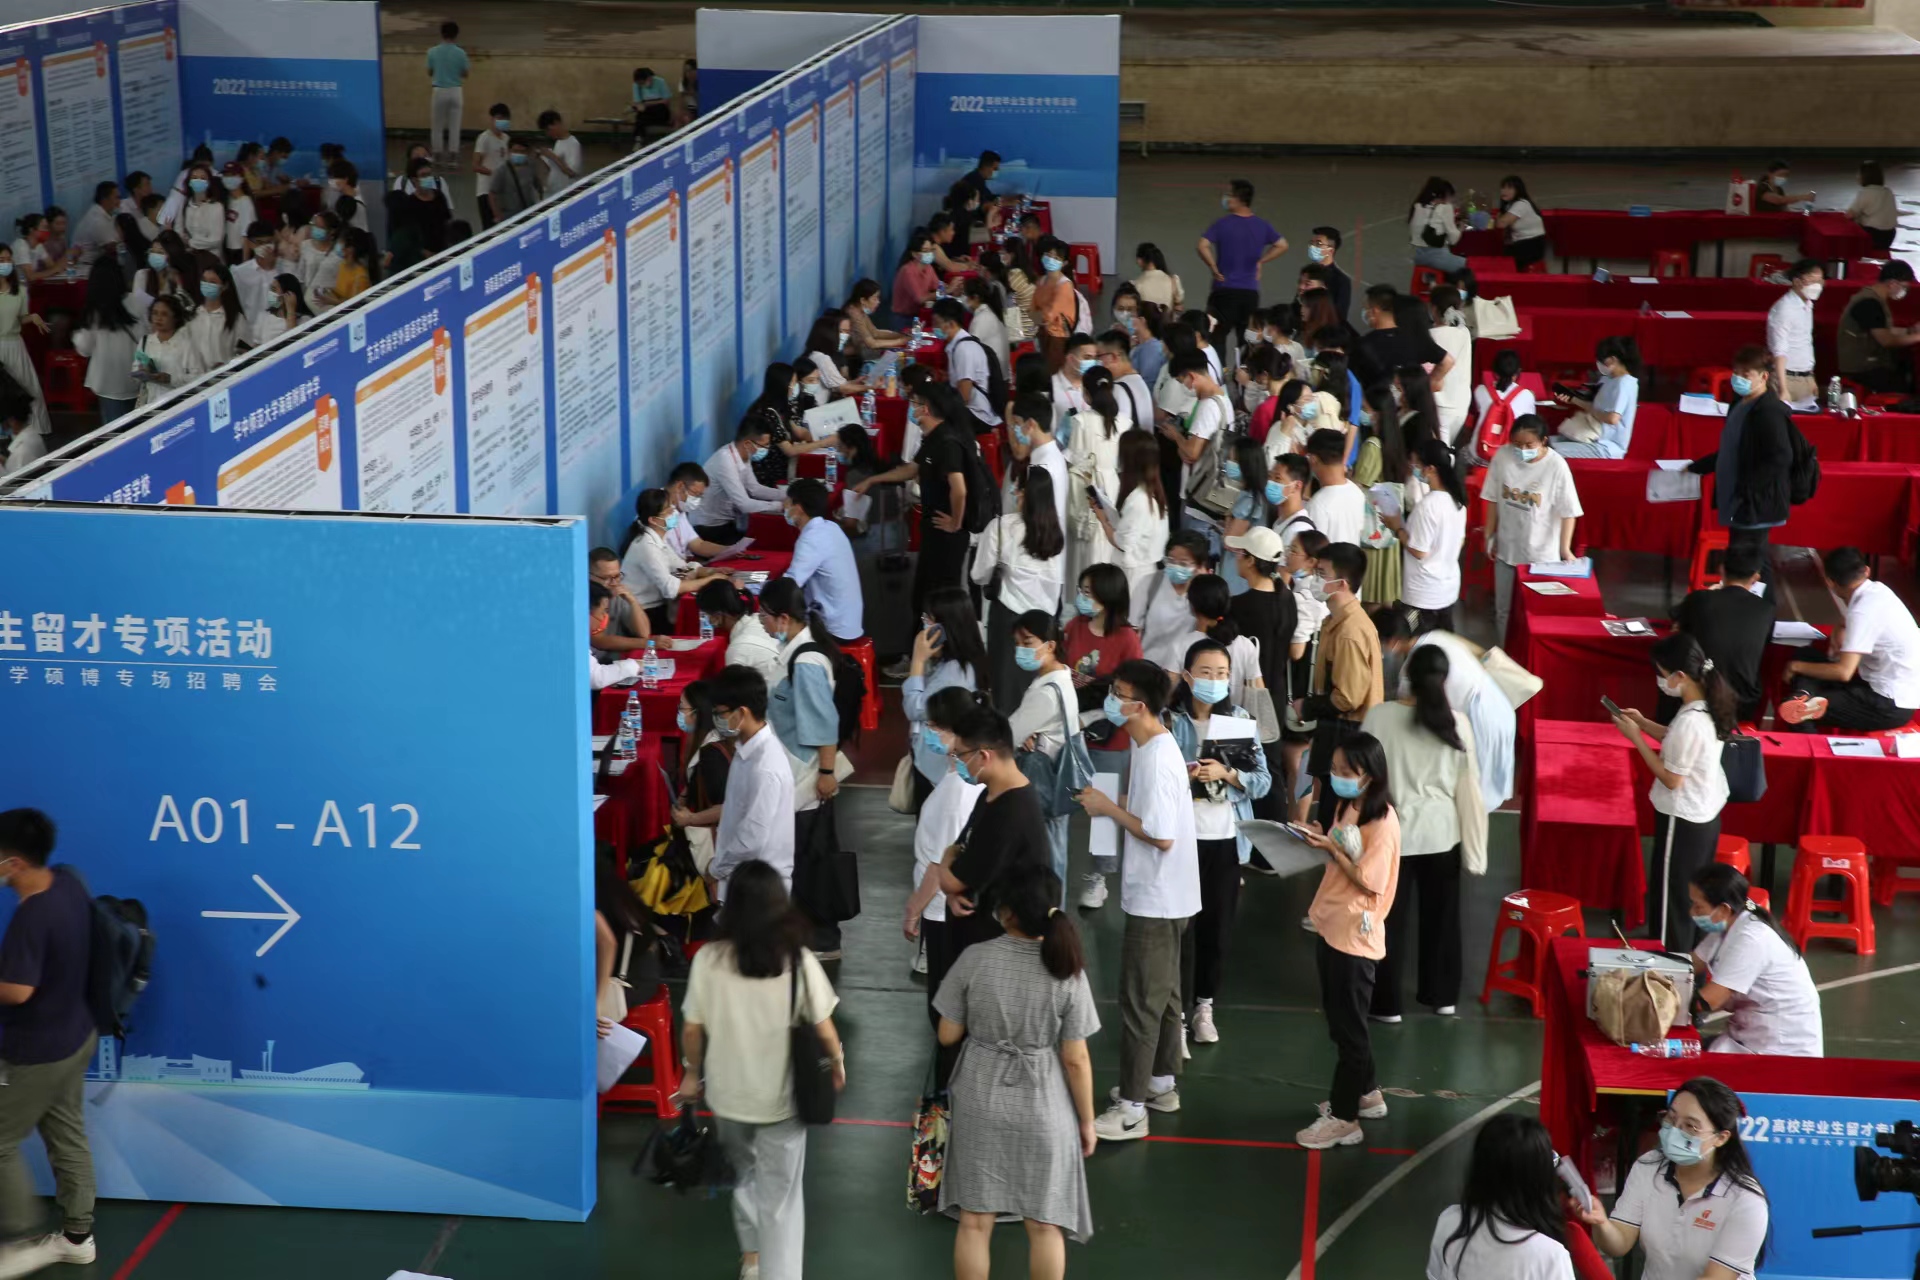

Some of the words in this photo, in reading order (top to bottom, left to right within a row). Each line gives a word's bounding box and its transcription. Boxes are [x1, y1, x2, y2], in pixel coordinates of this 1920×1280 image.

[213, 78, 246, 95] 2022
[950, 96, 984, 112] 2022
[0, 611, 273, 659] 生留才专项活动
[9, 666, 278, 692] 学硕博专场招聘会
[149, 795, 249, 845] A01
[313, 800, 421, 850] A12
[1738, 1116, 1770, 1142] 22
